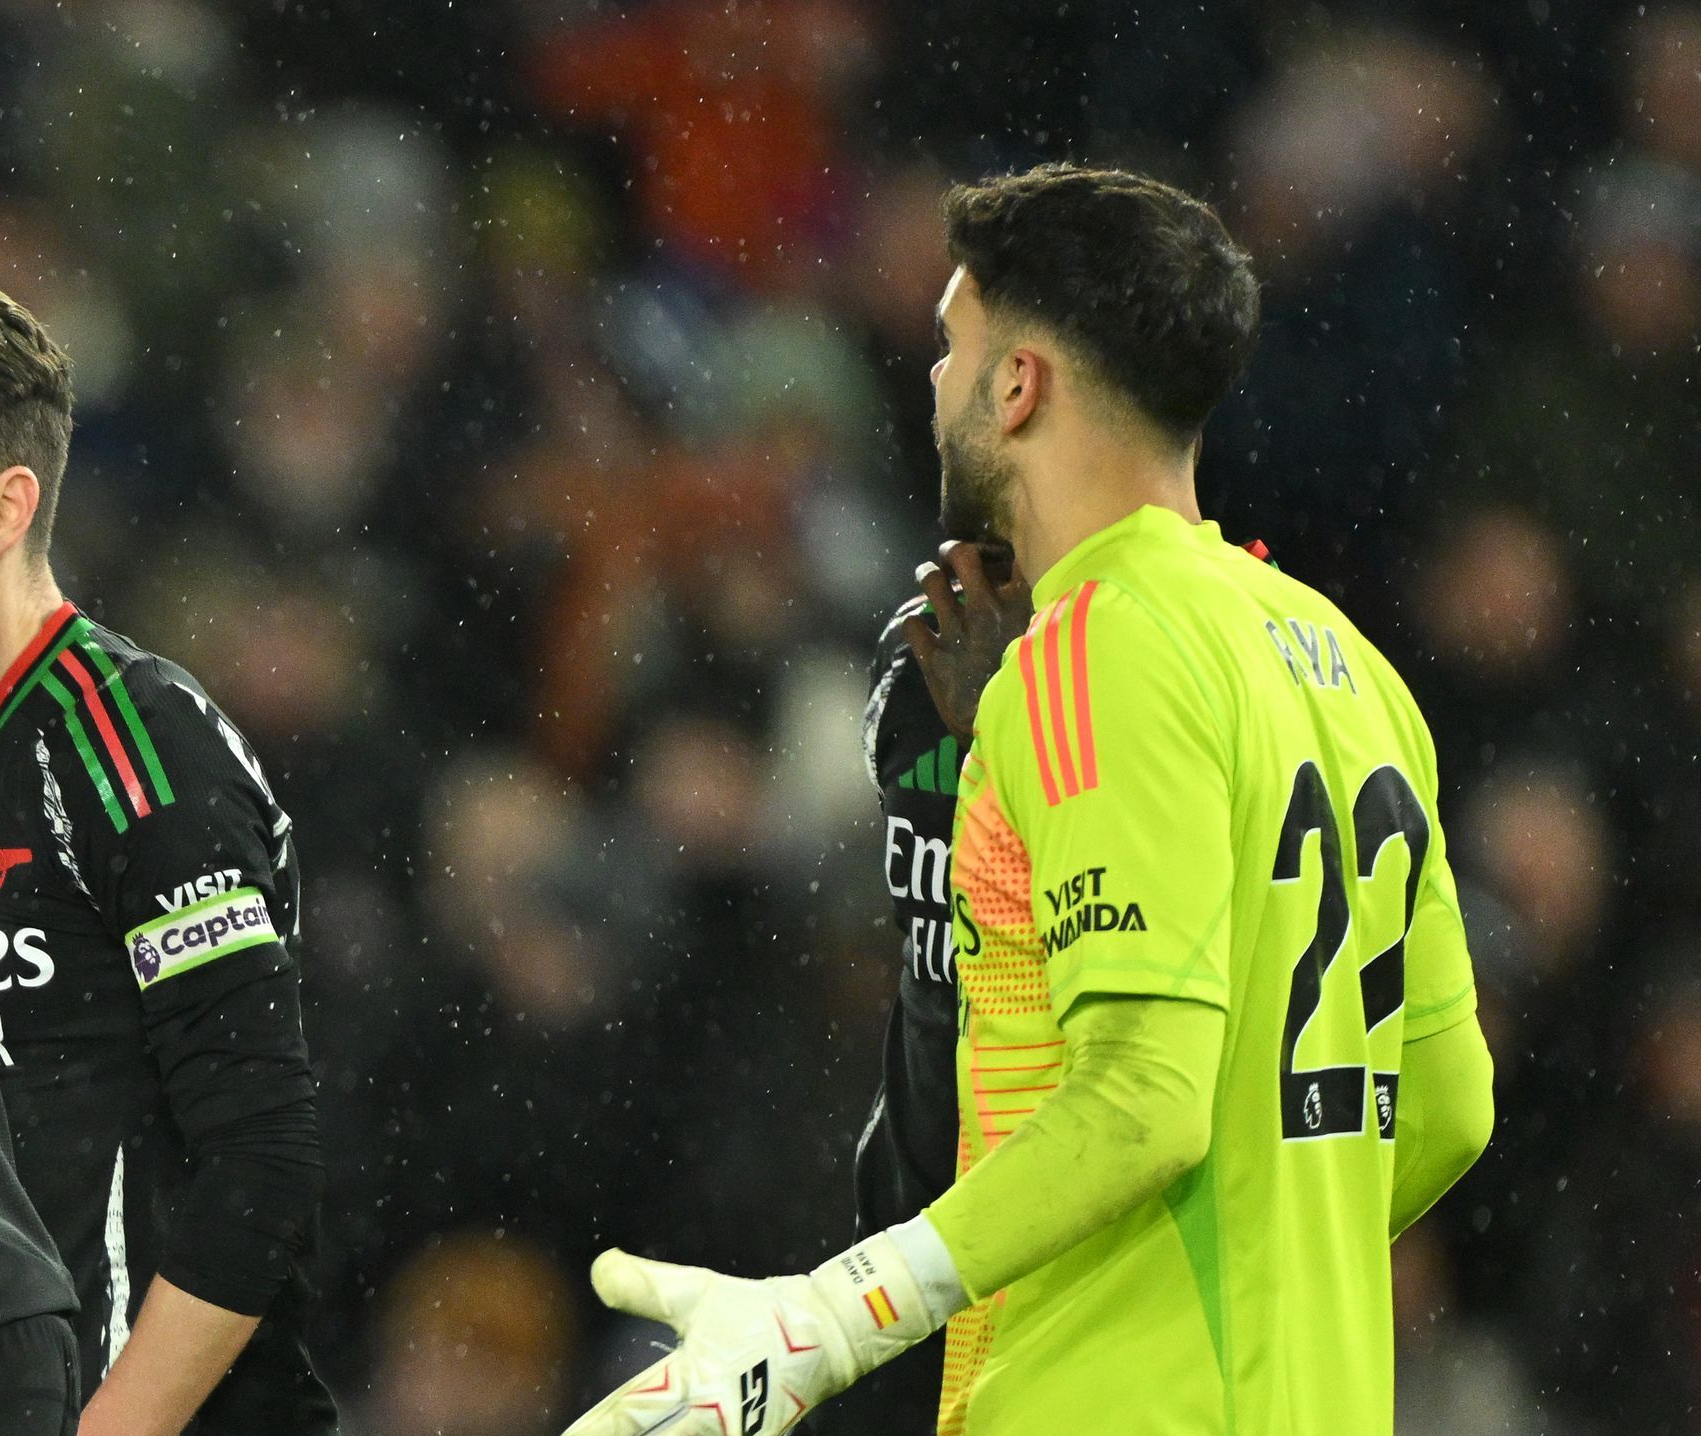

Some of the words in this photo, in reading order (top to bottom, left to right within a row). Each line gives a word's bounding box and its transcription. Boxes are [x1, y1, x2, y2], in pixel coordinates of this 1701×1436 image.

[155, 868, 243, 913] VISIT
[1044, 867, 1106, 916] VISIT
[1271, 759, 1432, 1142] 22
